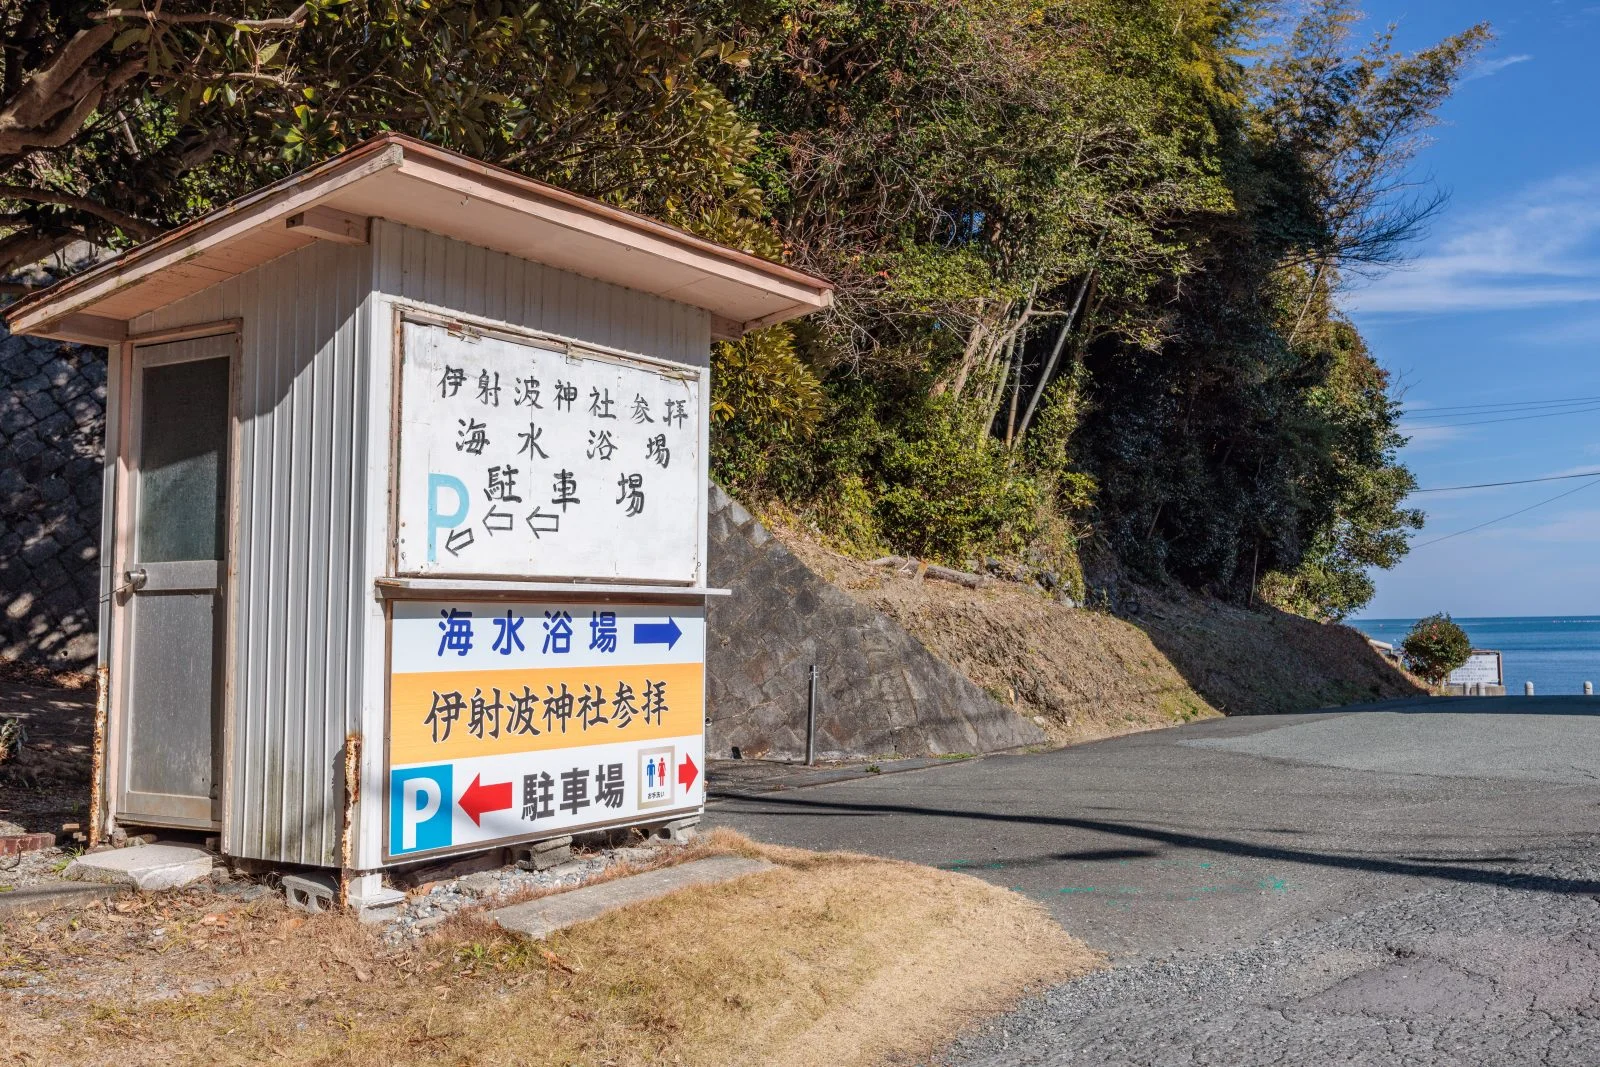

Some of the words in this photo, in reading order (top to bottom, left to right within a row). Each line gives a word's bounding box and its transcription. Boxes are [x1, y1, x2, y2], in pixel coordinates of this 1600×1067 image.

[427, 473, 470, 562] P
[437, 608, 618, 657] 海水浴場
[424, 679, 669, 744] 伊射波神社参拝
[402, 777, 442, 850] P
[521, 762, 625, 821] 駐車場
